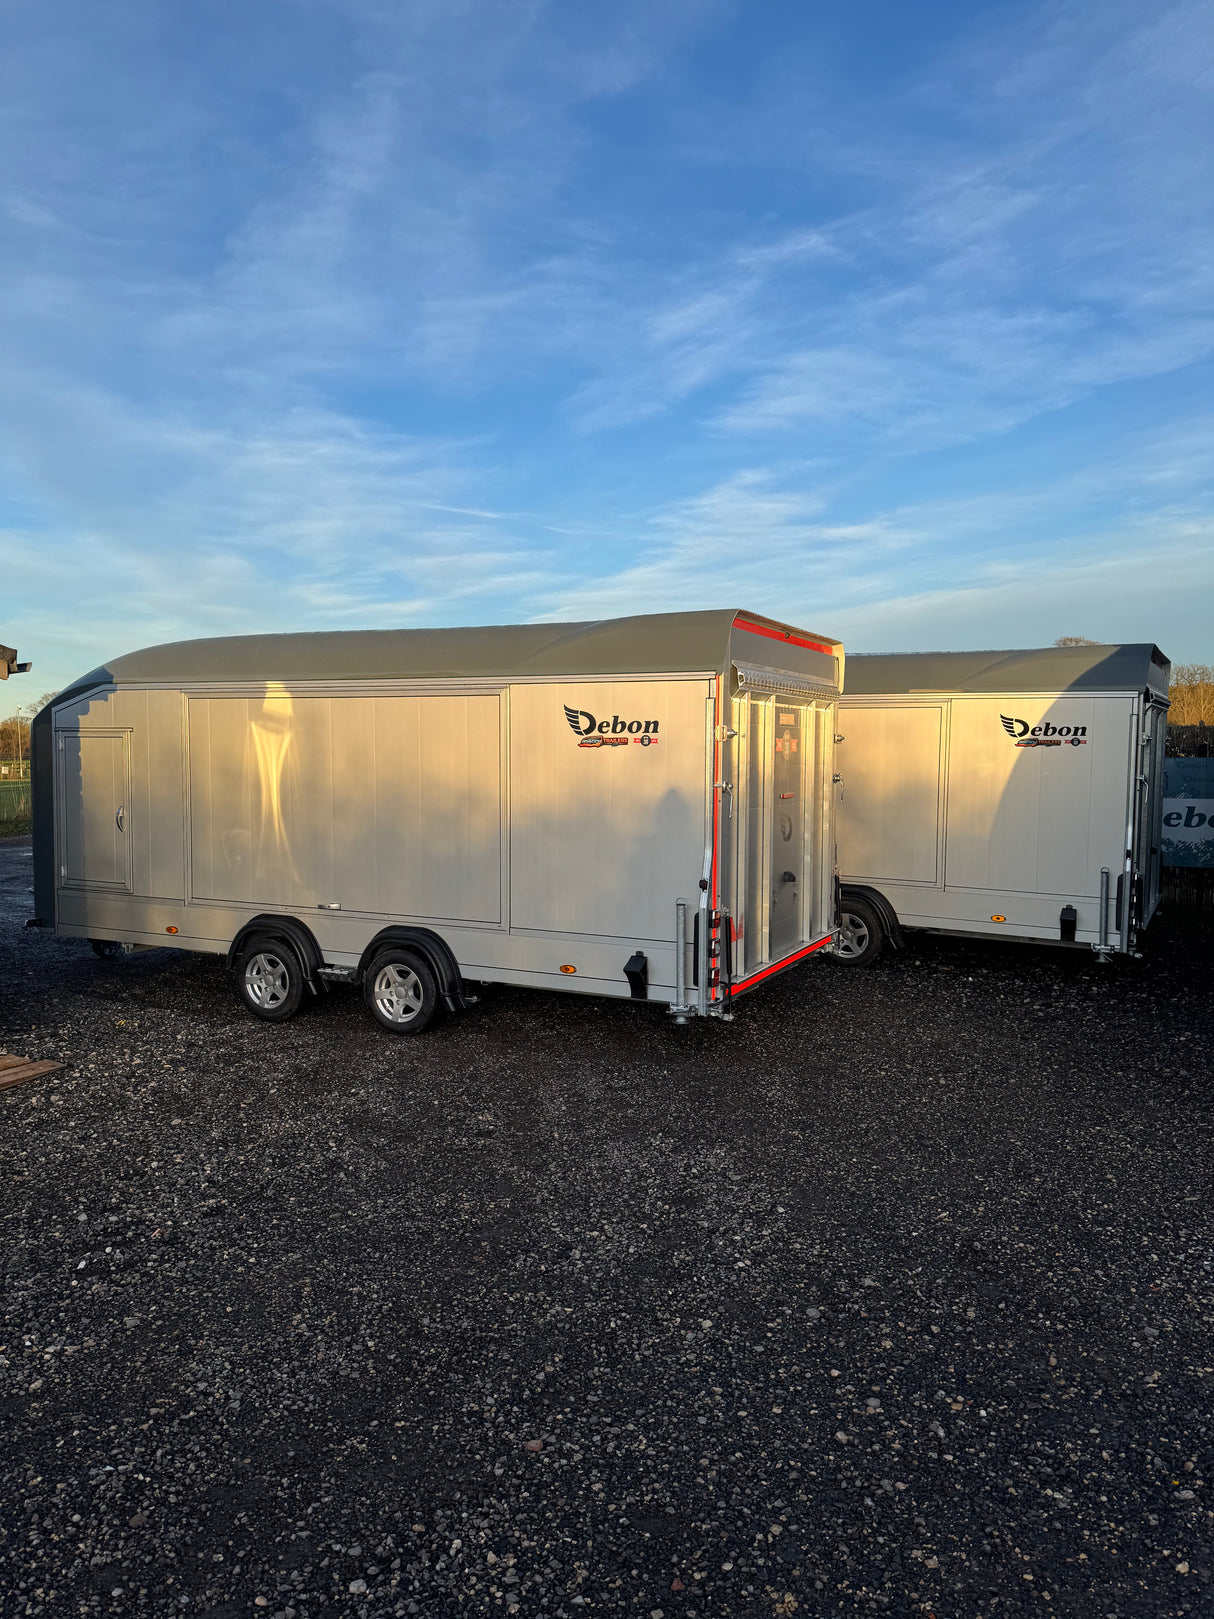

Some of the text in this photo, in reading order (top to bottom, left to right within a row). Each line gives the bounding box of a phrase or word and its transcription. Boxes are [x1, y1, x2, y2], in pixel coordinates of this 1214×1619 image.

[564, 704, 660, 736] Debon
[1000, 713, 1087, 738] Debon
[1163, 805, 1214, 828] eb
